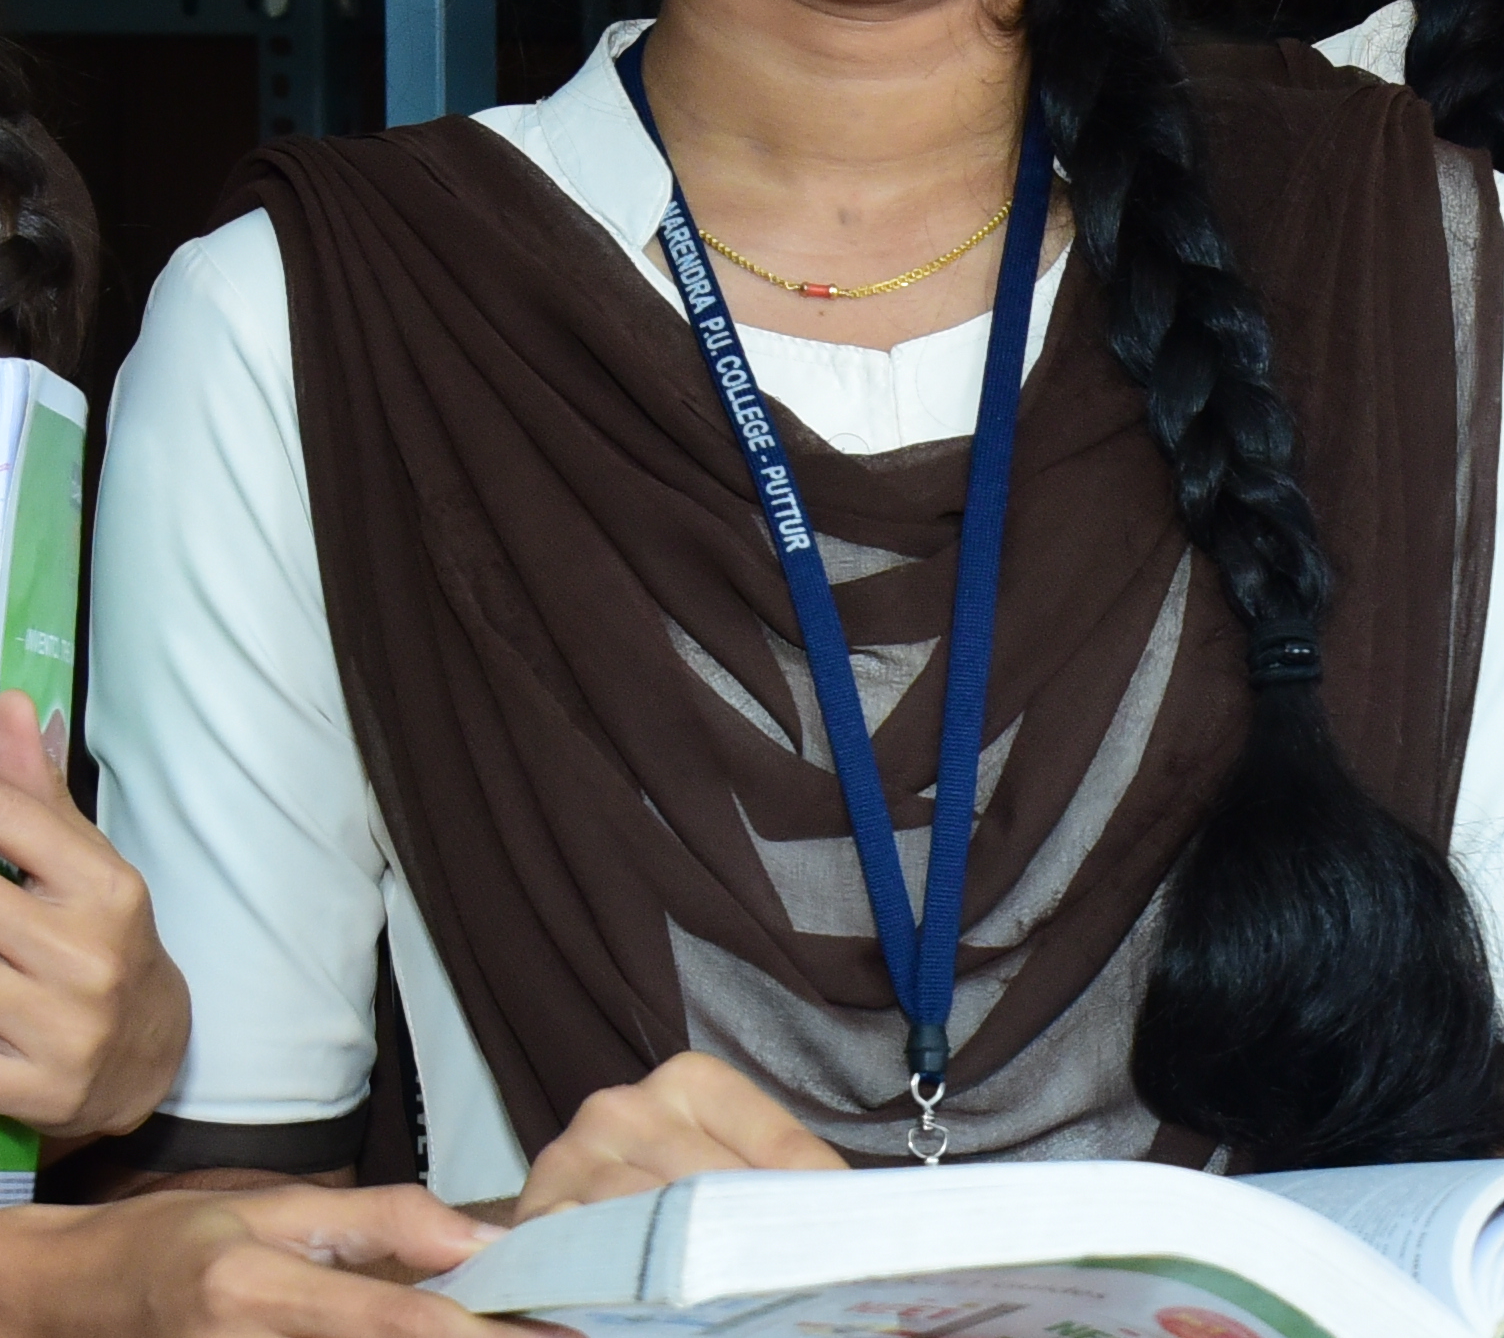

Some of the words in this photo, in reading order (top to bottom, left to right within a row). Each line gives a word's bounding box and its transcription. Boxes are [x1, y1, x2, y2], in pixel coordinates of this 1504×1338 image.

[660, 200, 716, 315] NARENDRA
[699, 317, 732, 357] P.U.
[716, 356, 775, 455] COLLEGE
[761, 466, 810, 553] PUTTUR
